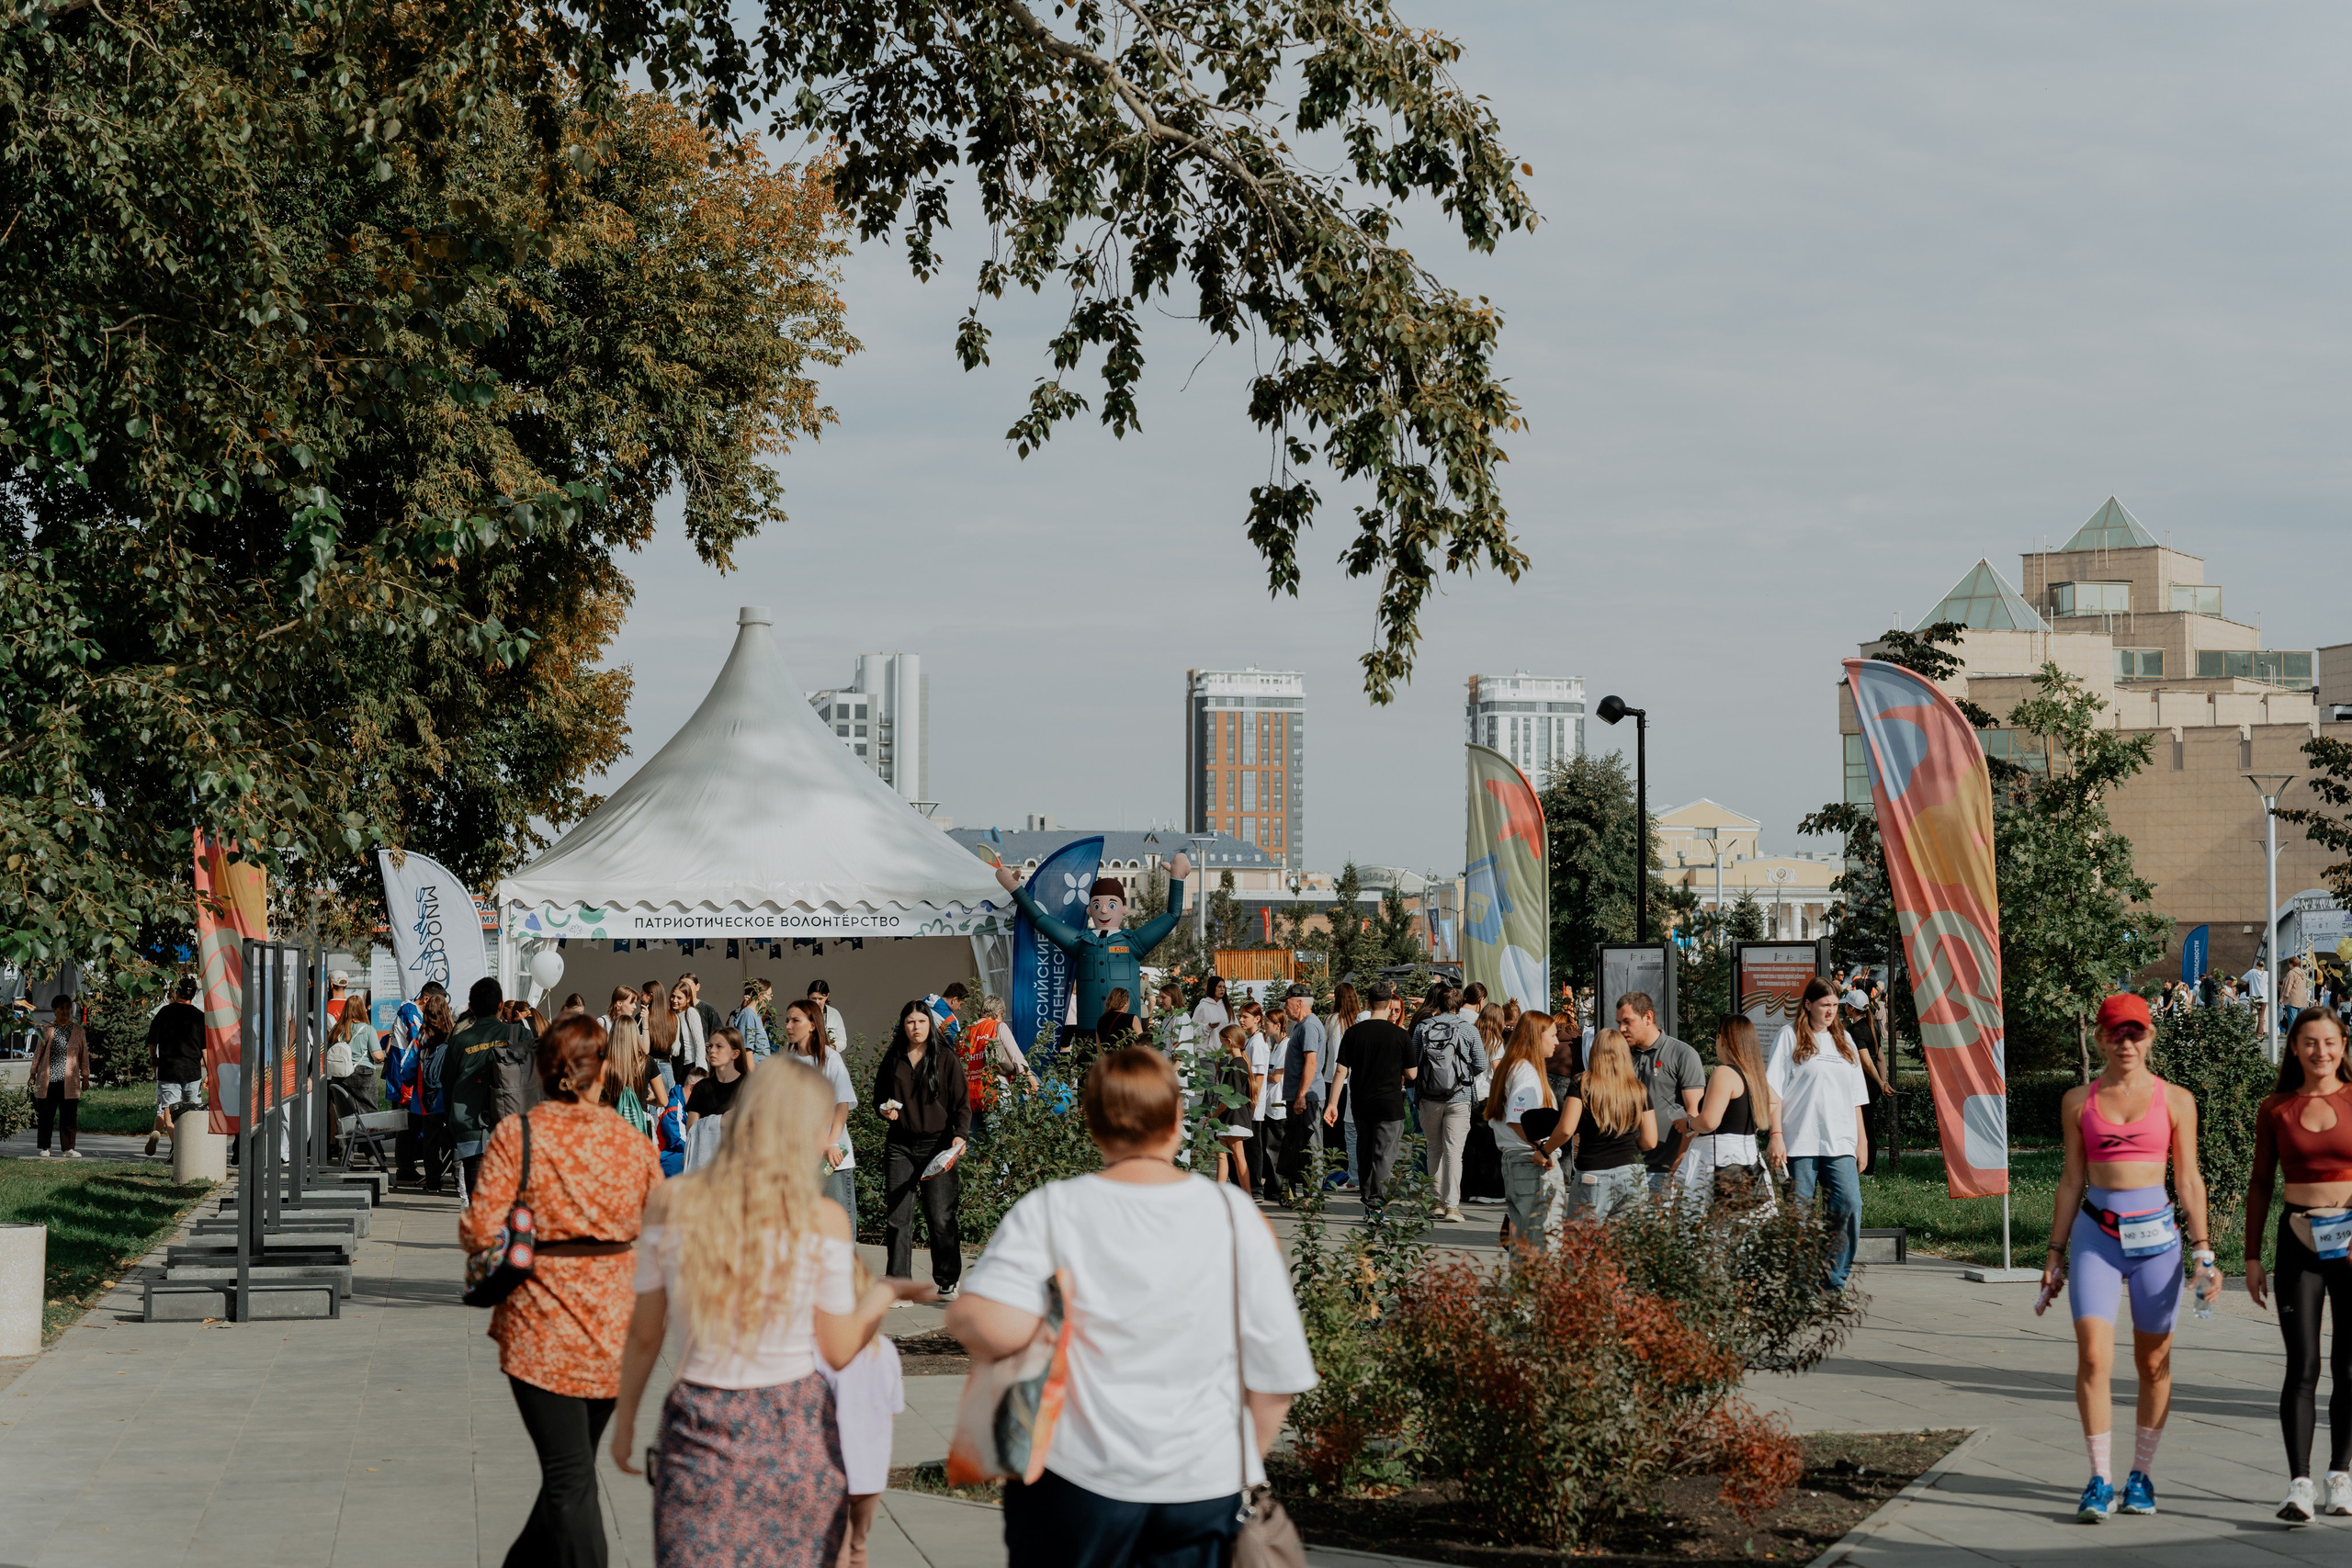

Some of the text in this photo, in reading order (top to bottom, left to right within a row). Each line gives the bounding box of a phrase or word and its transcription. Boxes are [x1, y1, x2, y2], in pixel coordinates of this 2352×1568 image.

[481, 916, 499, 924] МУ
[634, 914, 900, 929] ПАТРИОТИЧЕСКОЕ ВОЛОНТЁРСТВО
[2140, 1229, 2158, 1238] 320
[2335, 1230, 2351, 1240] 319
